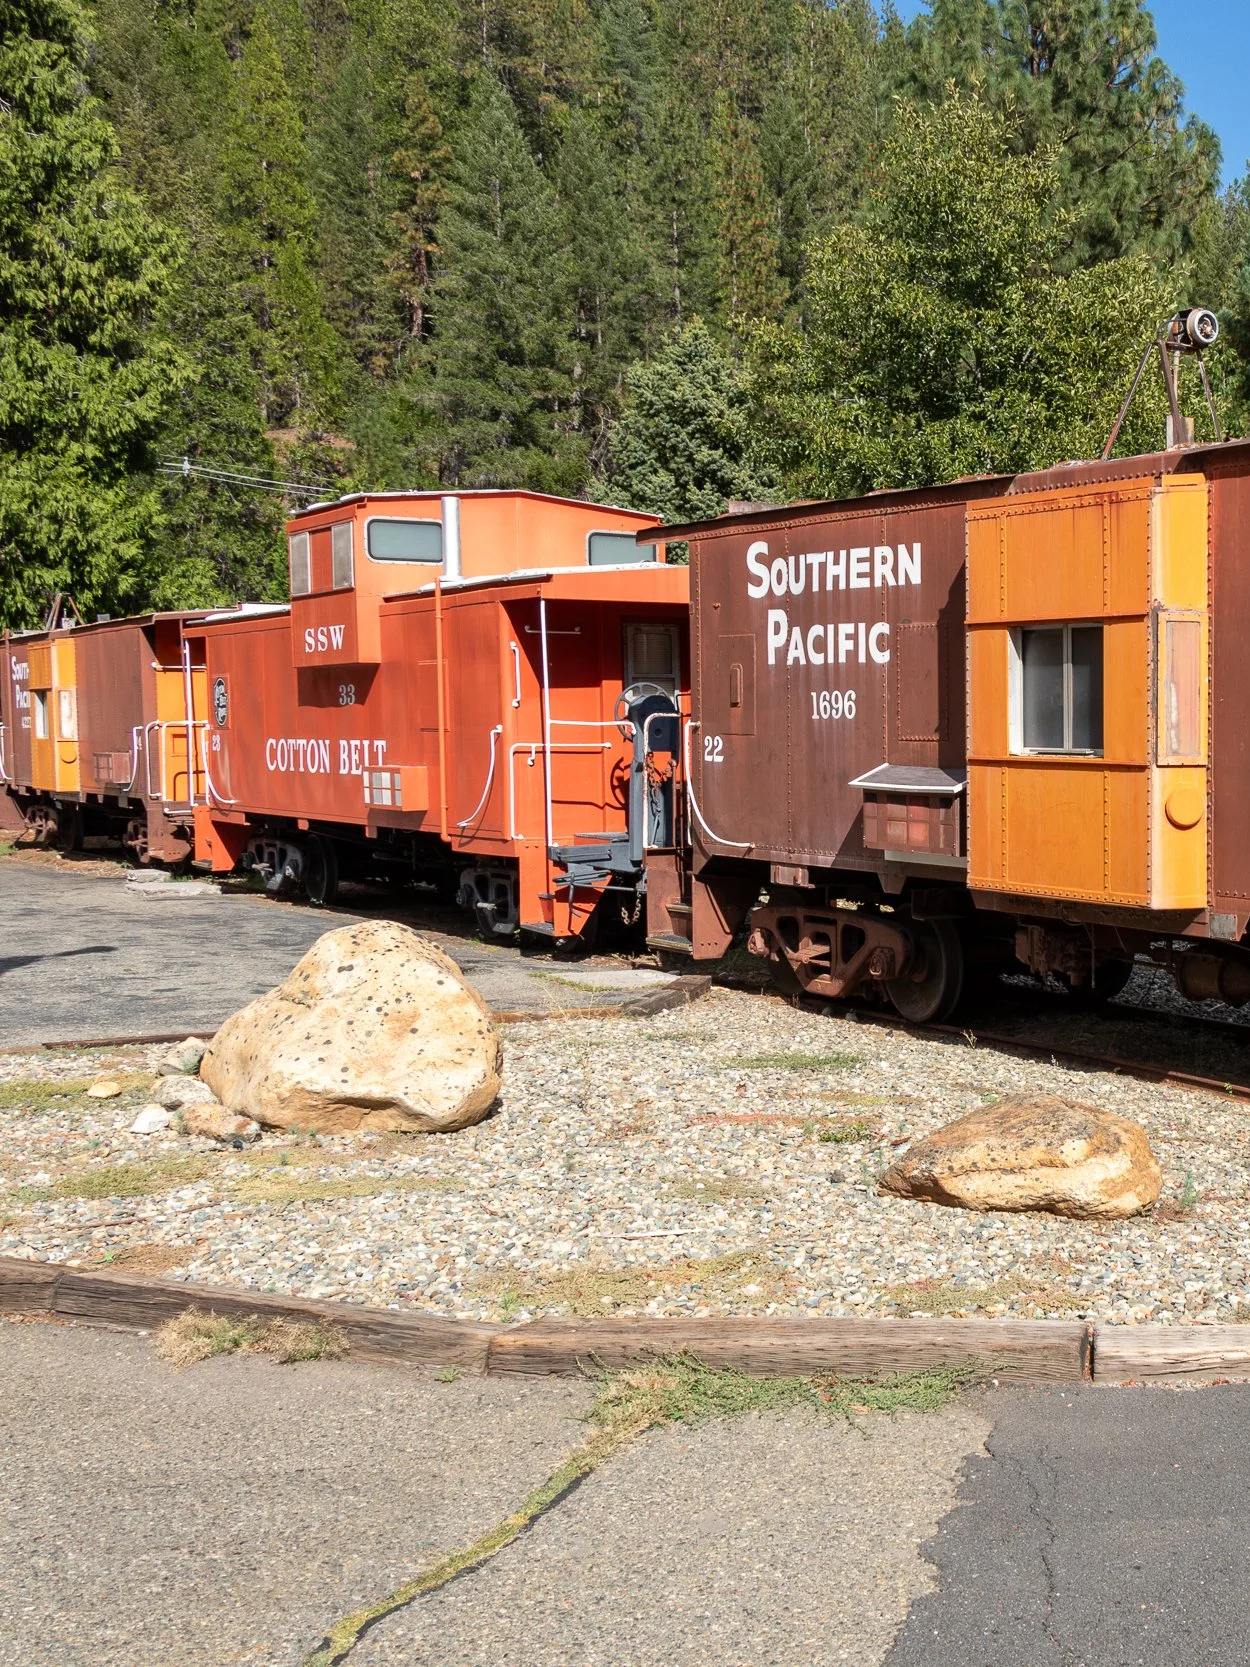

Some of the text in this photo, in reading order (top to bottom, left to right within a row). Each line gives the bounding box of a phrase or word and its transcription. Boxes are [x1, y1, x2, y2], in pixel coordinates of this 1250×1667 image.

[746, 541, 922, 598] SOUTHERN
[305, 625, 345, 653] SSW
[767, 609, 891, 665] PACIFIC
[339, 684, 356, 706] 33
[811, 690, 857, 719] 1696
[266, 738, 330, 774] COTTON
[704, 735, 725, 762] 22
